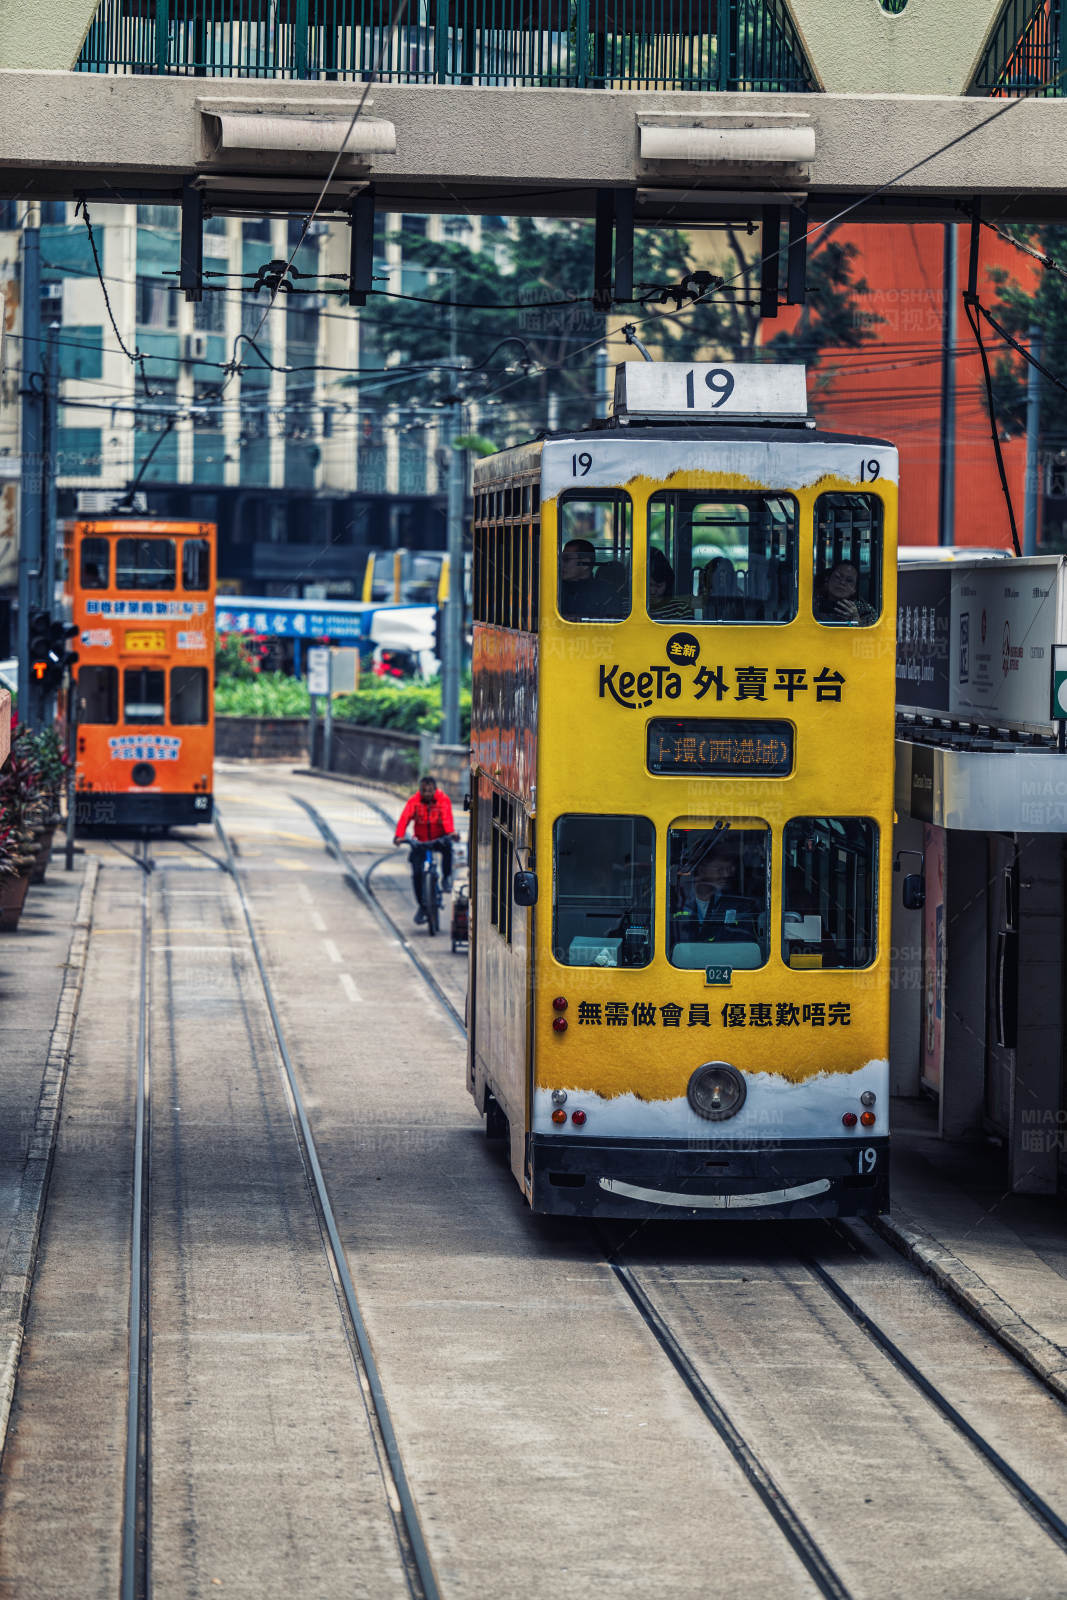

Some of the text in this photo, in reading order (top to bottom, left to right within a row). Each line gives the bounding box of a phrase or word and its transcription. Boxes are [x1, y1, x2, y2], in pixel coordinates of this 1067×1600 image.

[686, 369, 736, 409] 19
[572, 453, 593, 477] 19
[860, 459, 880, 483] 19
[670, 642, 696, 658] 全新
[599, 664, 683, 709] KeeTa
[692, 665, 847, 703] 外賣平台
[708, 969, 729, 980] 024
[578, 1001, 851, 1027] 無需做會員 優惠歎唔完
[858, 1148, 877, 1175] 19
